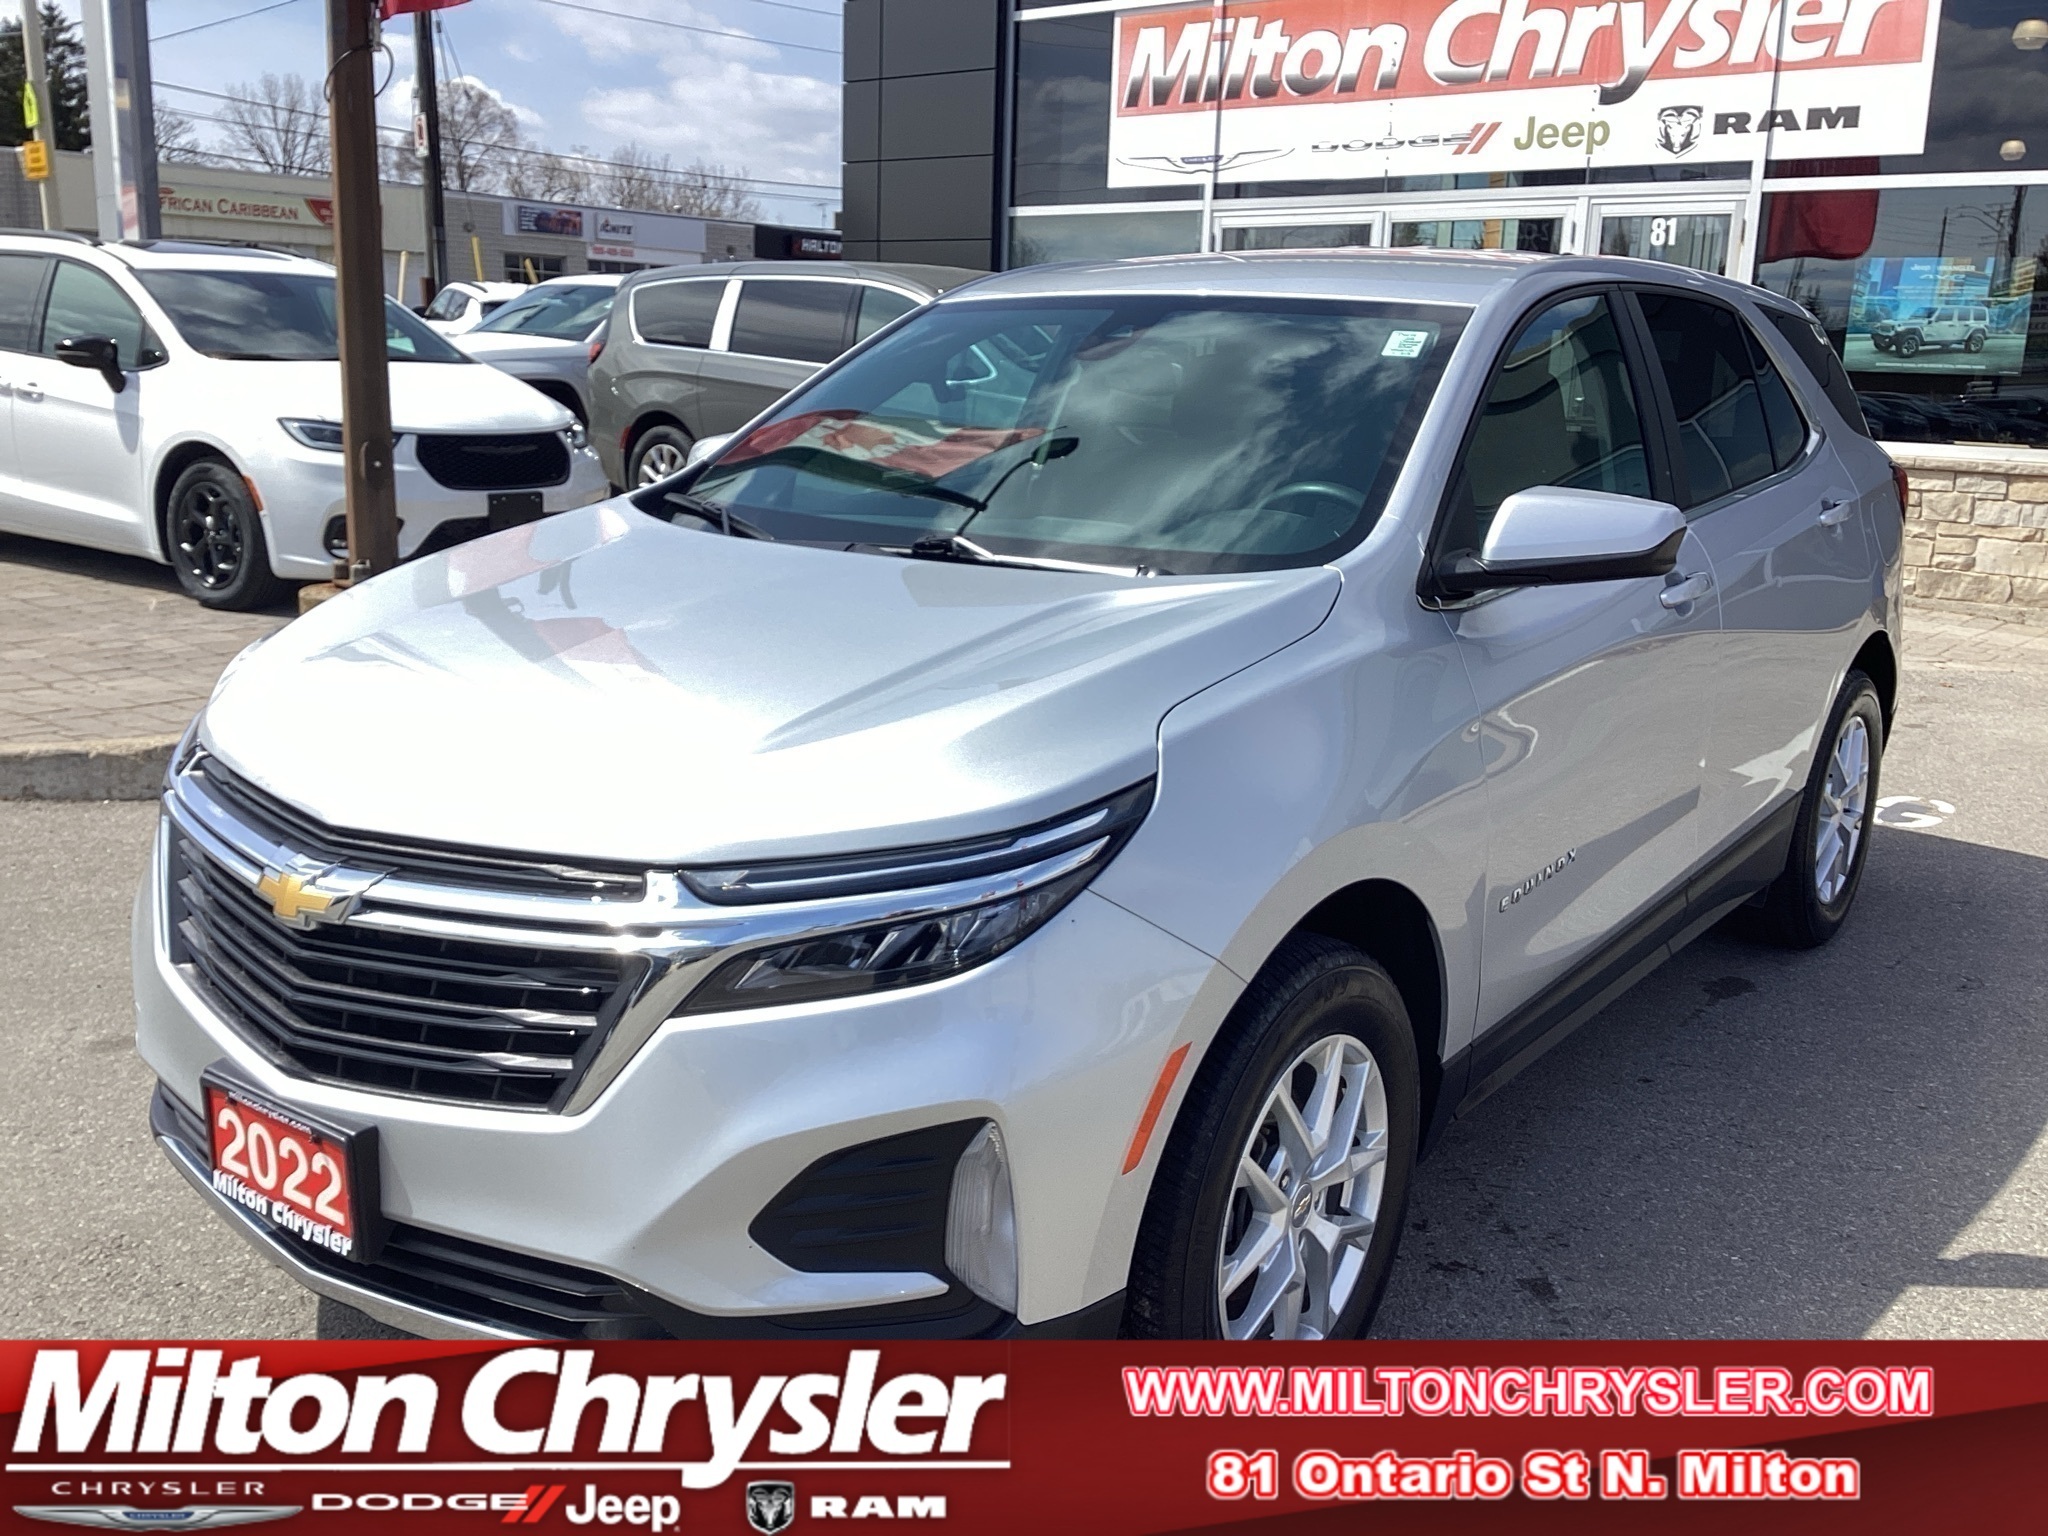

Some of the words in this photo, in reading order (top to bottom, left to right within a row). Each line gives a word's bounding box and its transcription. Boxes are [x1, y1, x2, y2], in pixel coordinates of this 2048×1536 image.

[1123, 15, 1409, 109] Milton
[1422, 0, 1896, 106] Chrysler
[1514, 116, 1611, 155] Jeep
[1713, 105, 1862, 136] RAM
[1311, 129, 1473, 153] DODGE
[160, 196, 213, 214] FRICAN
[216, 198, 299, 220] CARIBBEAN
[1650, 217, 1678, 246] 81
[1498, 848, 1578, 914] EQUINOX
[217, 1107, 346, 1227] 2022
[212, 1168, 269, 1216] Milton
[271, 1200, 353, 1257] Chrysler
